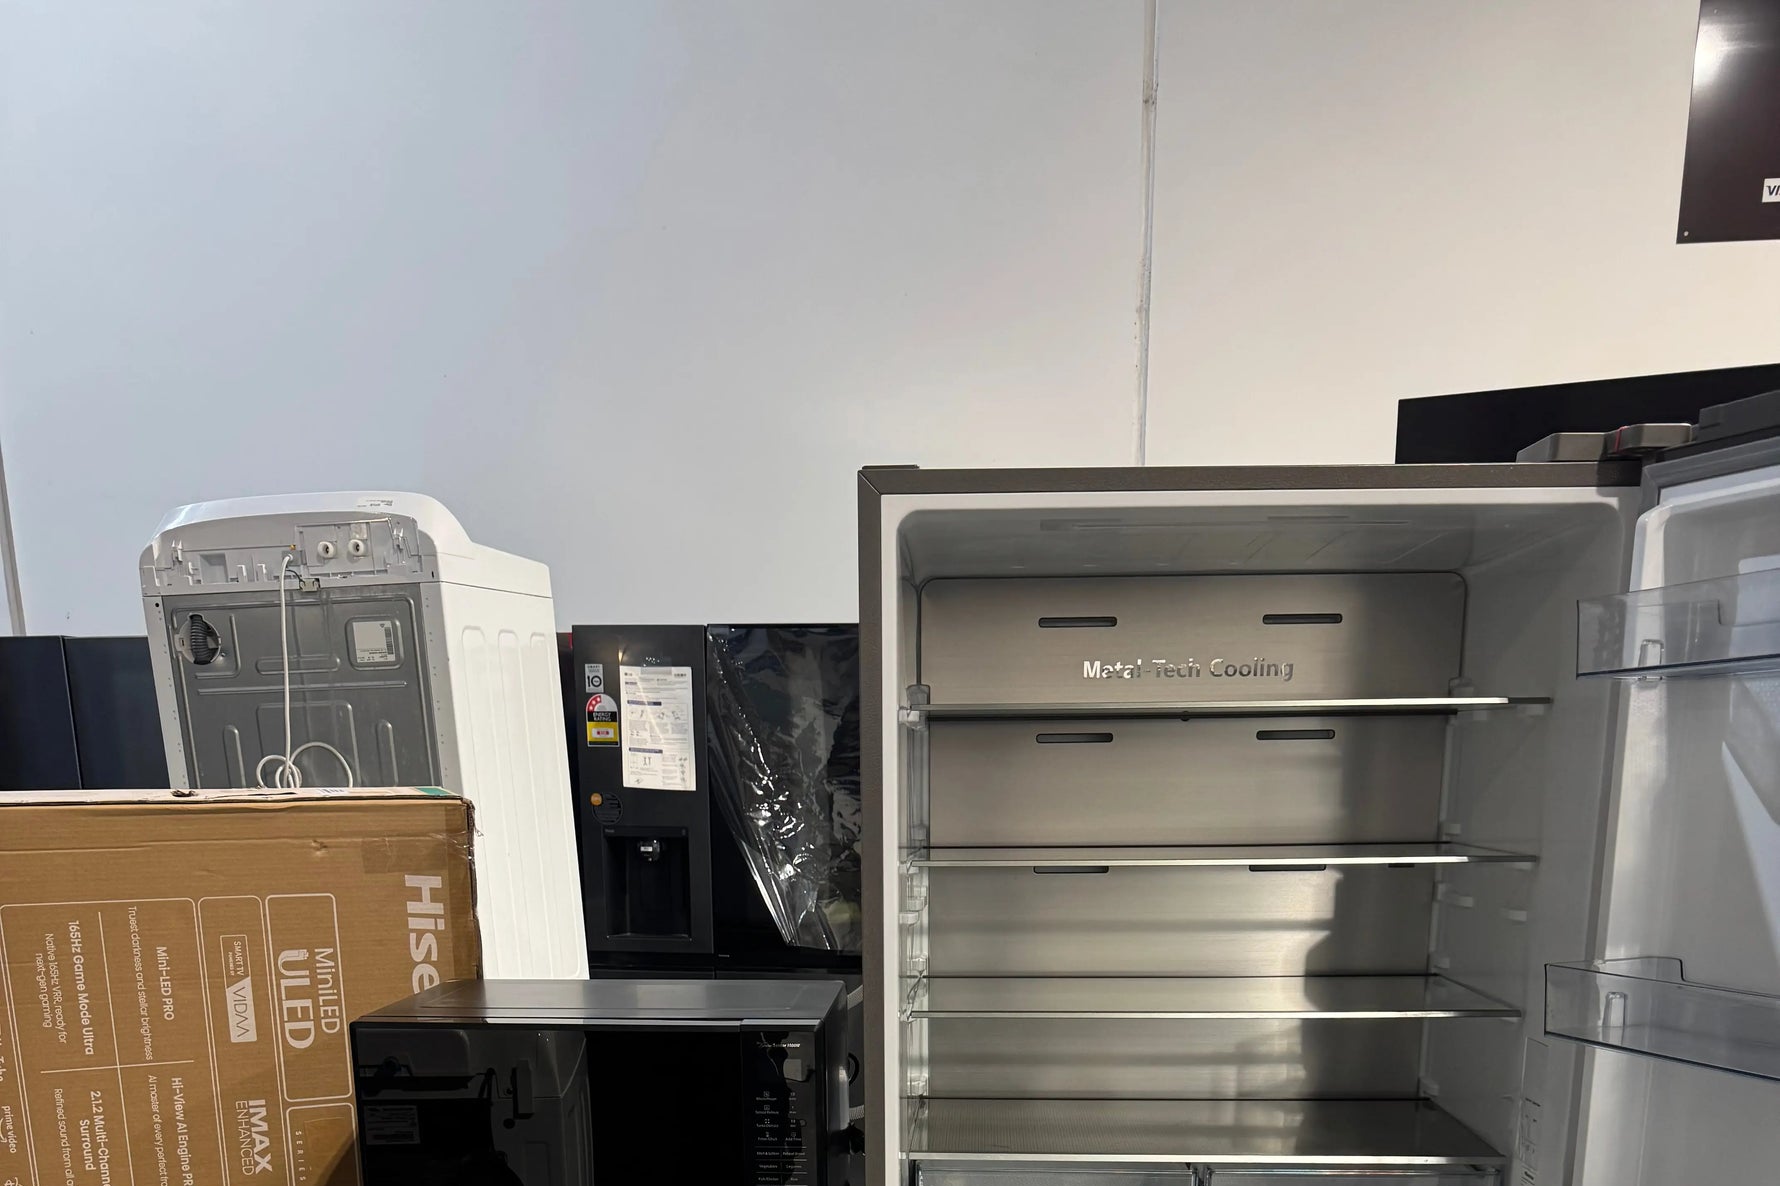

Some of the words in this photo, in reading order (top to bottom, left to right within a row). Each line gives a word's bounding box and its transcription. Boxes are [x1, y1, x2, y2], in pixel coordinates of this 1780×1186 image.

[1766, 185, 1780, 196] VI
[587, 675, 602, 687] 10
[1209, 657, 1294, 682] Cooling
[128, 905, 139, 932] Truest
[45, 933, 56, 960] Native
[68, 920, 82, 953] 165Hz
[404, 874, 445, 994] Hise
[131, 933, 142, 972] darkness
[233, 941, 243, 967] SMART
[35, 953, 47, 993] next-gen
[49, 961, 60, 985] 165Hz
[73, 954, 86, 991] Game
[135, 973, 146, 990] and
[156, 946, 172, 996] Mini-LED
[138, 990, 149, 1017] stellar
[277, 948, 315, 1049] ULED
[314, 947, 340, 1034] MiniLED
[38, 993, 53, 1028] gaming
[54, 1005, 66, 1031] ready
[77, 992, 91, 1026] Mode
[162, 997, 175, 1021] PRO
[233, 986, 250, 1038] VIDAA
[57, 1030, 67, 1044] for
[82, 1027, 95, 1055] Ultra
[140, 1017, 153, 1060] brightness
[53, 1088, 67, 1120] Refined
[90, 1090, 103, 1113] 2.1.2
[149, 1083, 160, 1113] master
[171, 1077, 186, 1121] Hi-View
[1, 1105, 14, 1130] prime
[153, 1113, 161, 1123] of
[176, 1122, 187, 1133] AI
[7, 1130, 17, 1154] video
[57, 1120, 70, 1147] sound
[79, 1119, 96, 1171] Surround
[153, 1123, 164, 1147] every
[235, 1100, 255, 1176] ENHANCED
[249, 1099, 273, 1175] IMAX
[61, 1147, 72, 1169] from
[154, 1147, 168, 1177] perfect
[177, 1135, 192, 1172] Engine
[295, 1131, 307, 1181] SERIES
[64, 1169, 75, 1178] all
